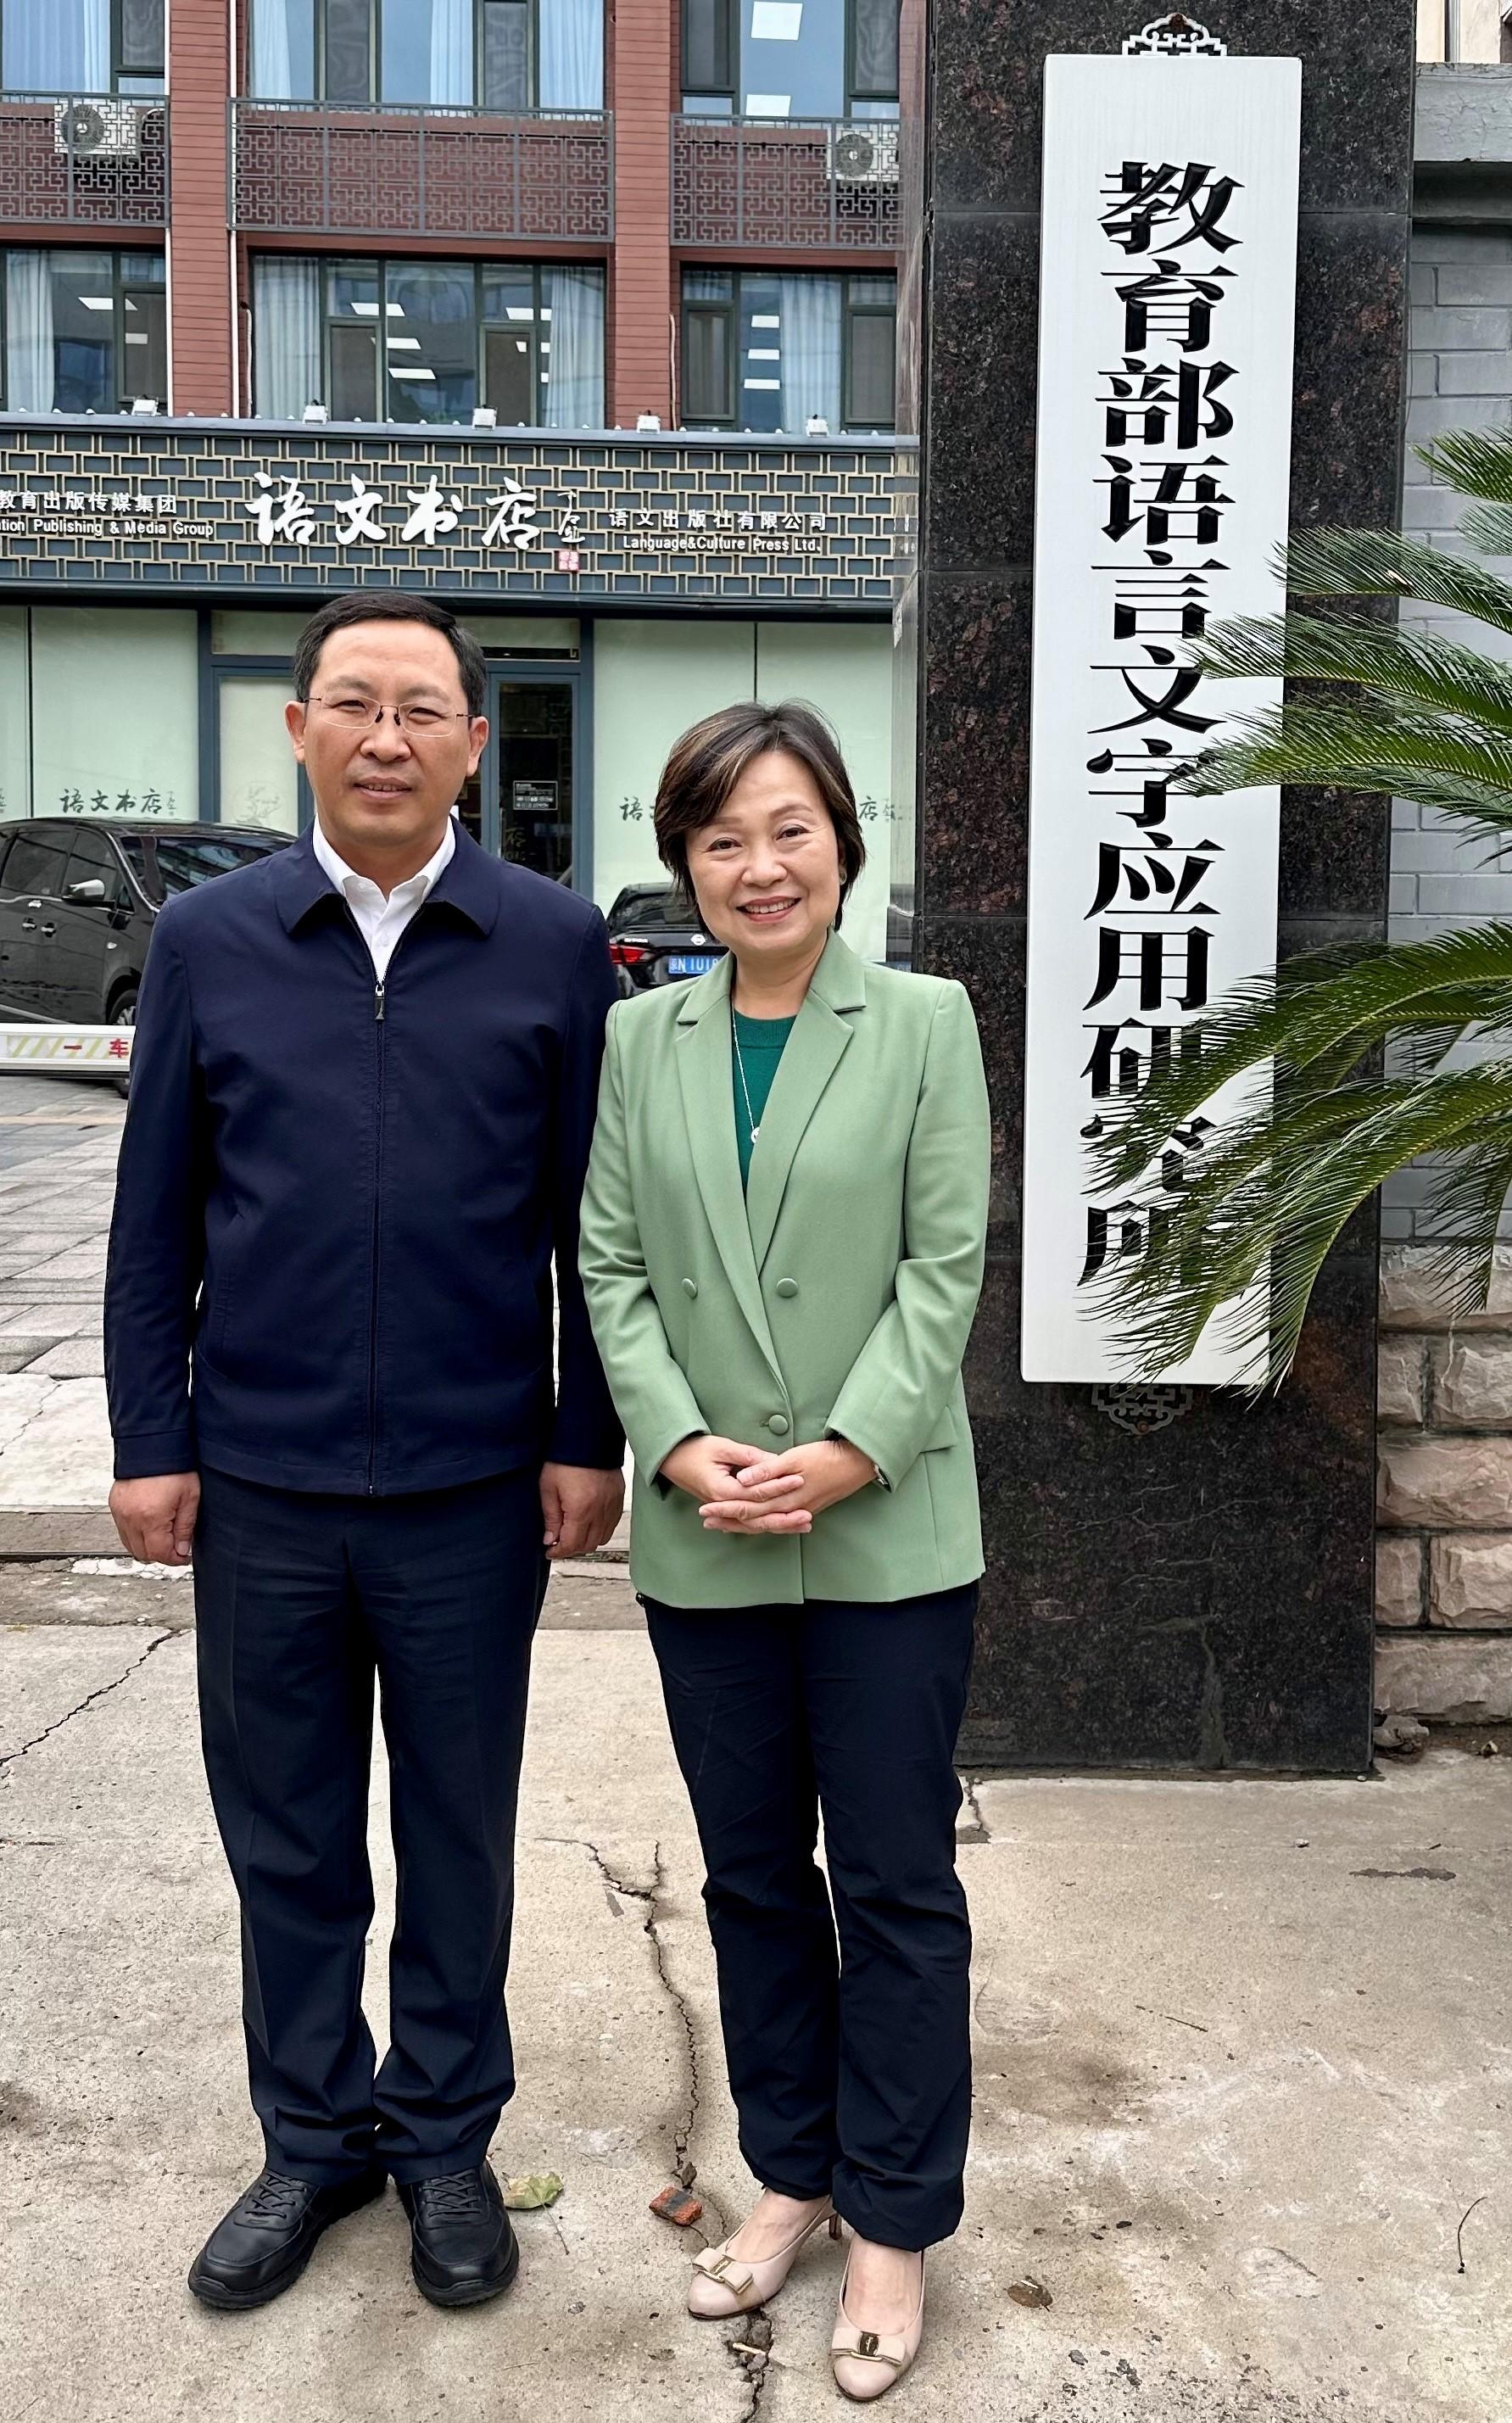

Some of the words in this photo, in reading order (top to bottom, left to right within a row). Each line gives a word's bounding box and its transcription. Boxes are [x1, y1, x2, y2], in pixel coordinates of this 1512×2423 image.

[0, 489, 177, 514] 教育出版传媒集团
[244, 471, 541, 550] 语文书店
[0, 519, 25, 532] tion
[34, 518, 103, 537] Publishing
[109, 523, 120, 534] &
[125, 521, 167, 534] Media
[173, 521, 214, 538] Group
[608, 507, 827, 532] 语文出版社有限公司
[623, 535, 745, 552] Language&Culture
[753, 539, 789, 551] Press
[795, 539, 822, 551] Ltd.
[59, 789, 163, 814] 语文书店
